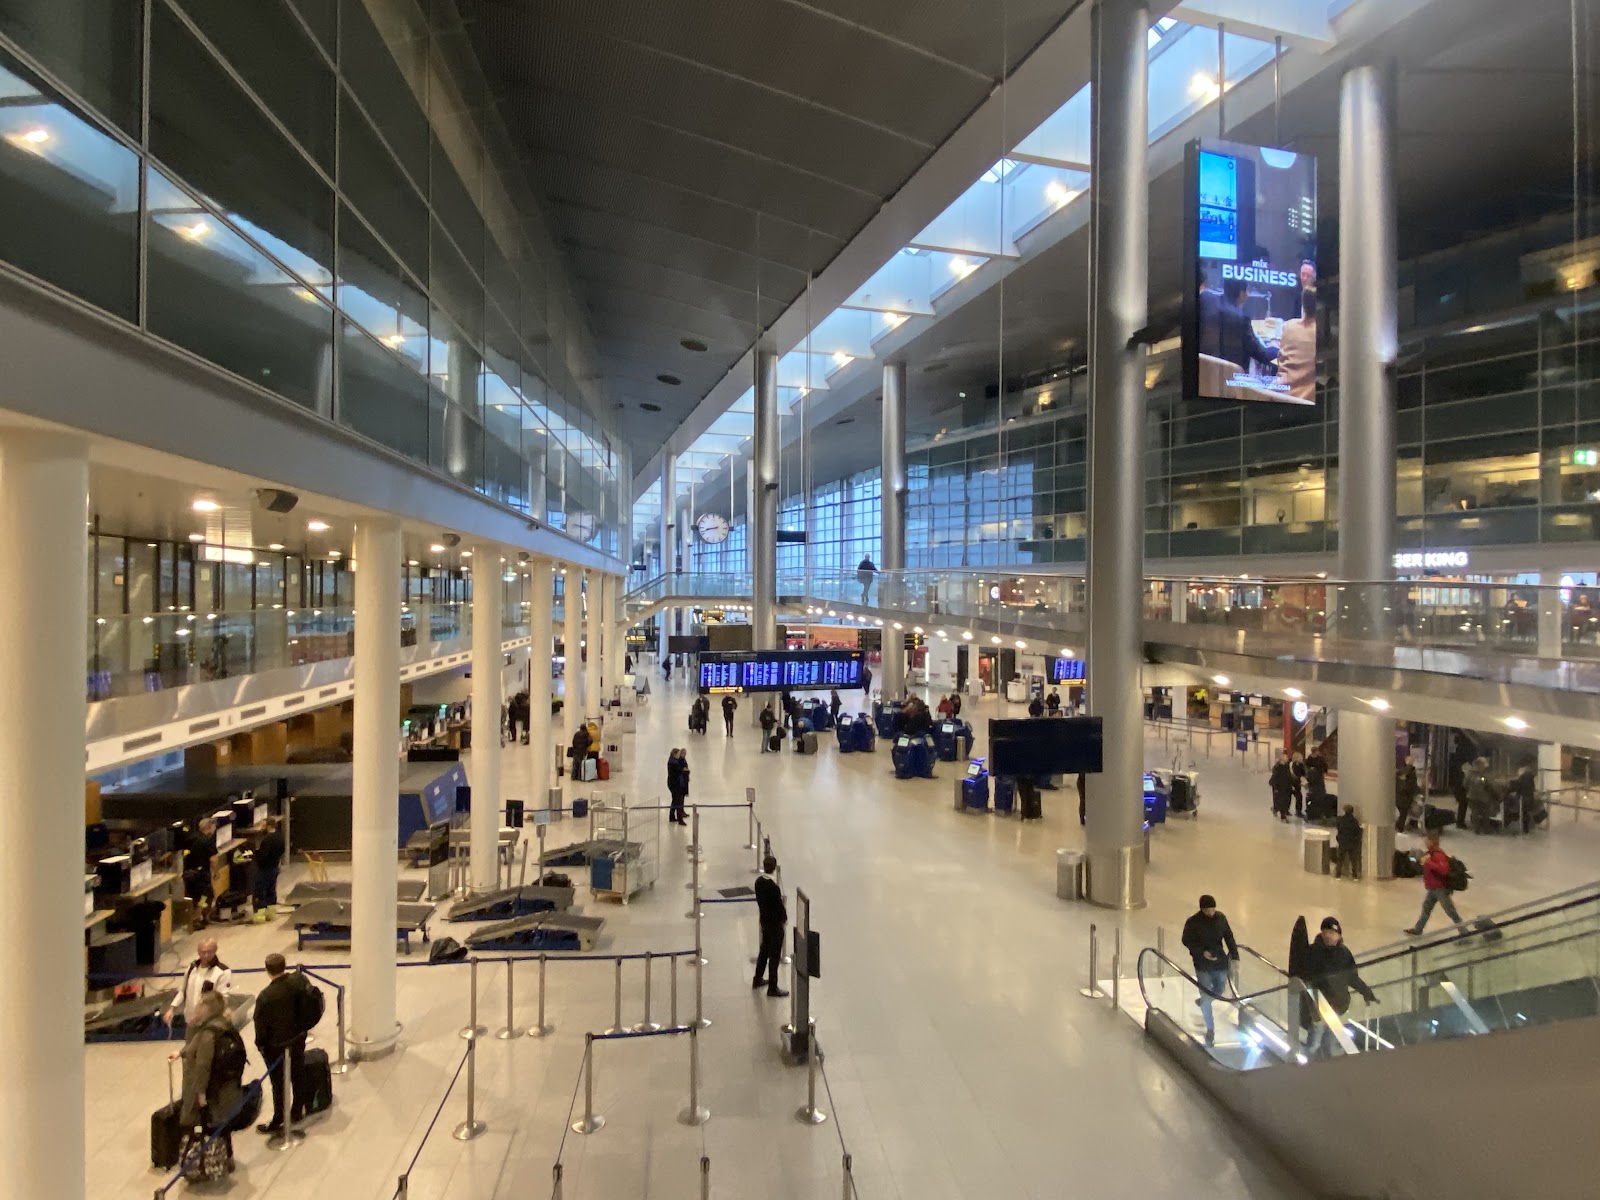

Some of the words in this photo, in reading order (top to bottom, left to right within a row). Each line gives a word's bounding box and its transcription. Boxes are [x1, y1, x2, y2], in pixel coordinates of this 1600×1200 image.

[1252, 258, 1268, 269] mix
[1222, 263, 1297, 287] BUSINESS
[1424, 551, 1468, 567] KING
